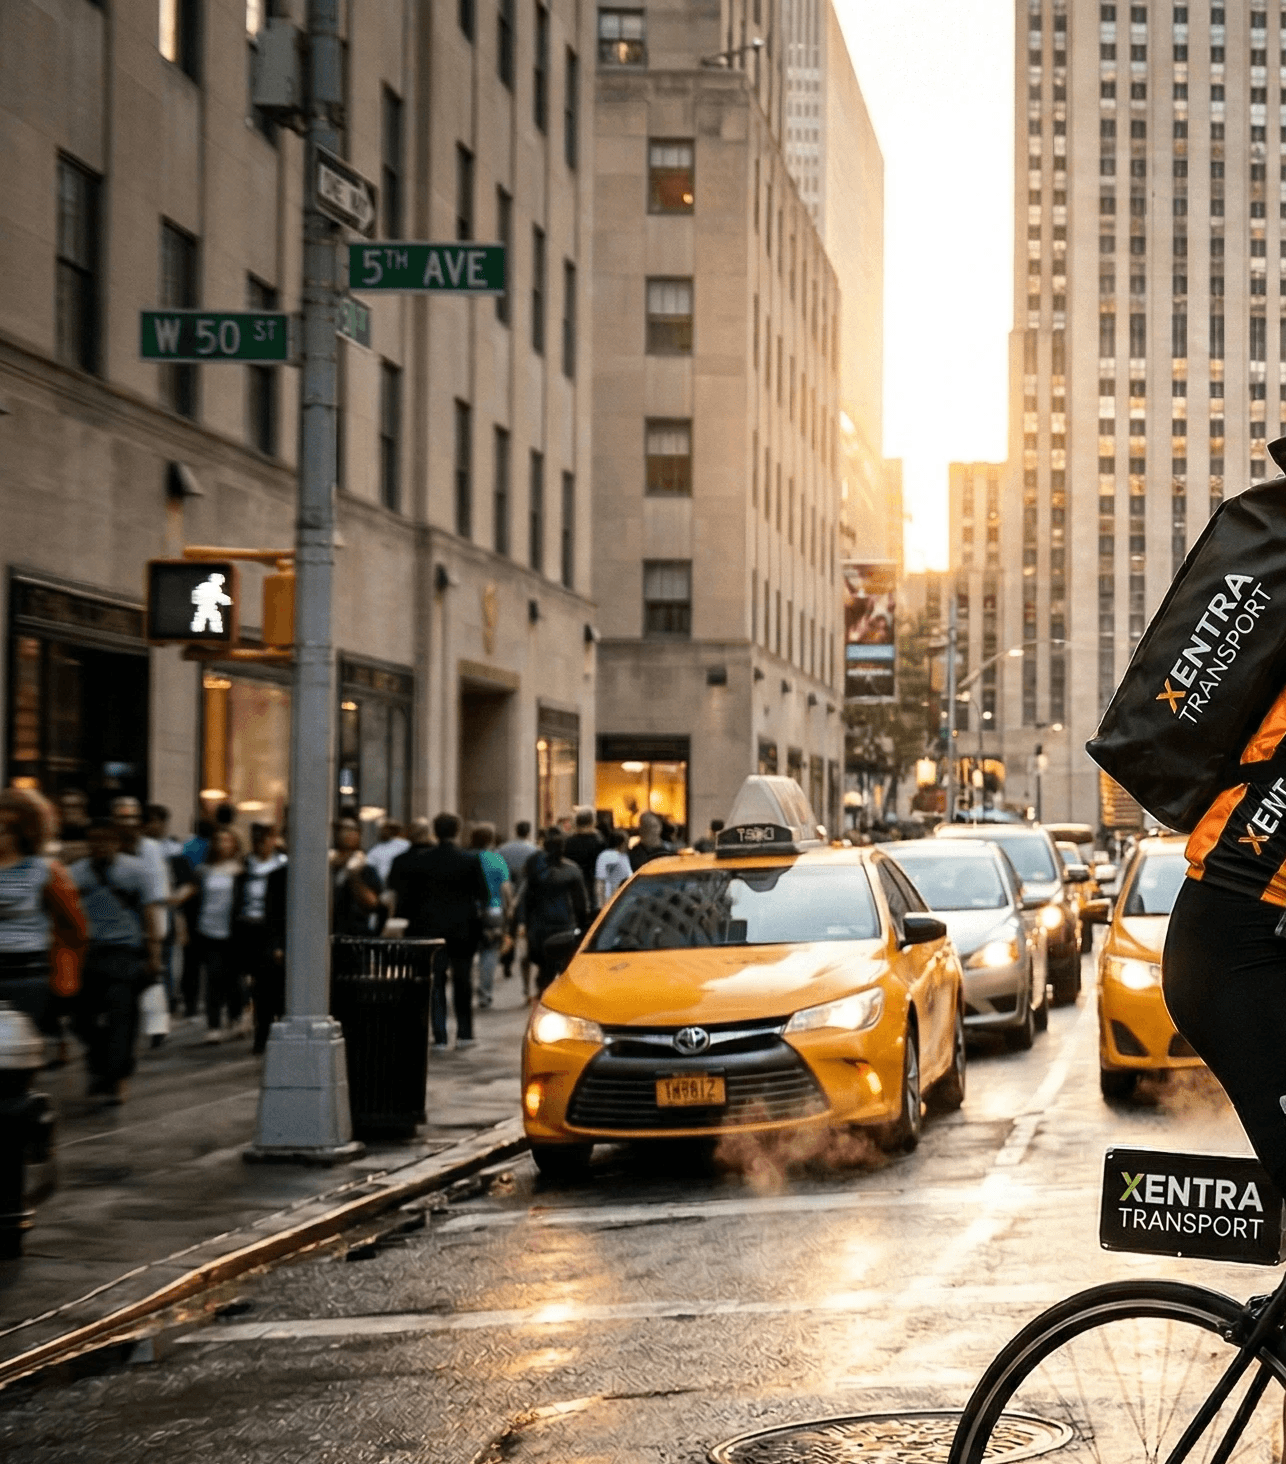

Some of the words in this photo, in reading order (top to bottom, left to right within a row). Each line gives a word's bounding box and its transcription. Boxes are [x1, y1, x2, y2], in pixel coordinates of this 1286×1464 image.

[361, 250, 409, 286] 5TH
[423, 250, 488, 288] AVE
[154, 319, 181, 355] W
[194, 319, 241, 355] 50
[252, 319, 277, 341] ST
[1156, 573, 1254, 714] XENTRA
[1178, 583, 1272, 724] TRANSPORT
[1119, 1171, 1264, 1212] XENTRA
[1118, 1207, 1264, 1239] TRANSPORT
